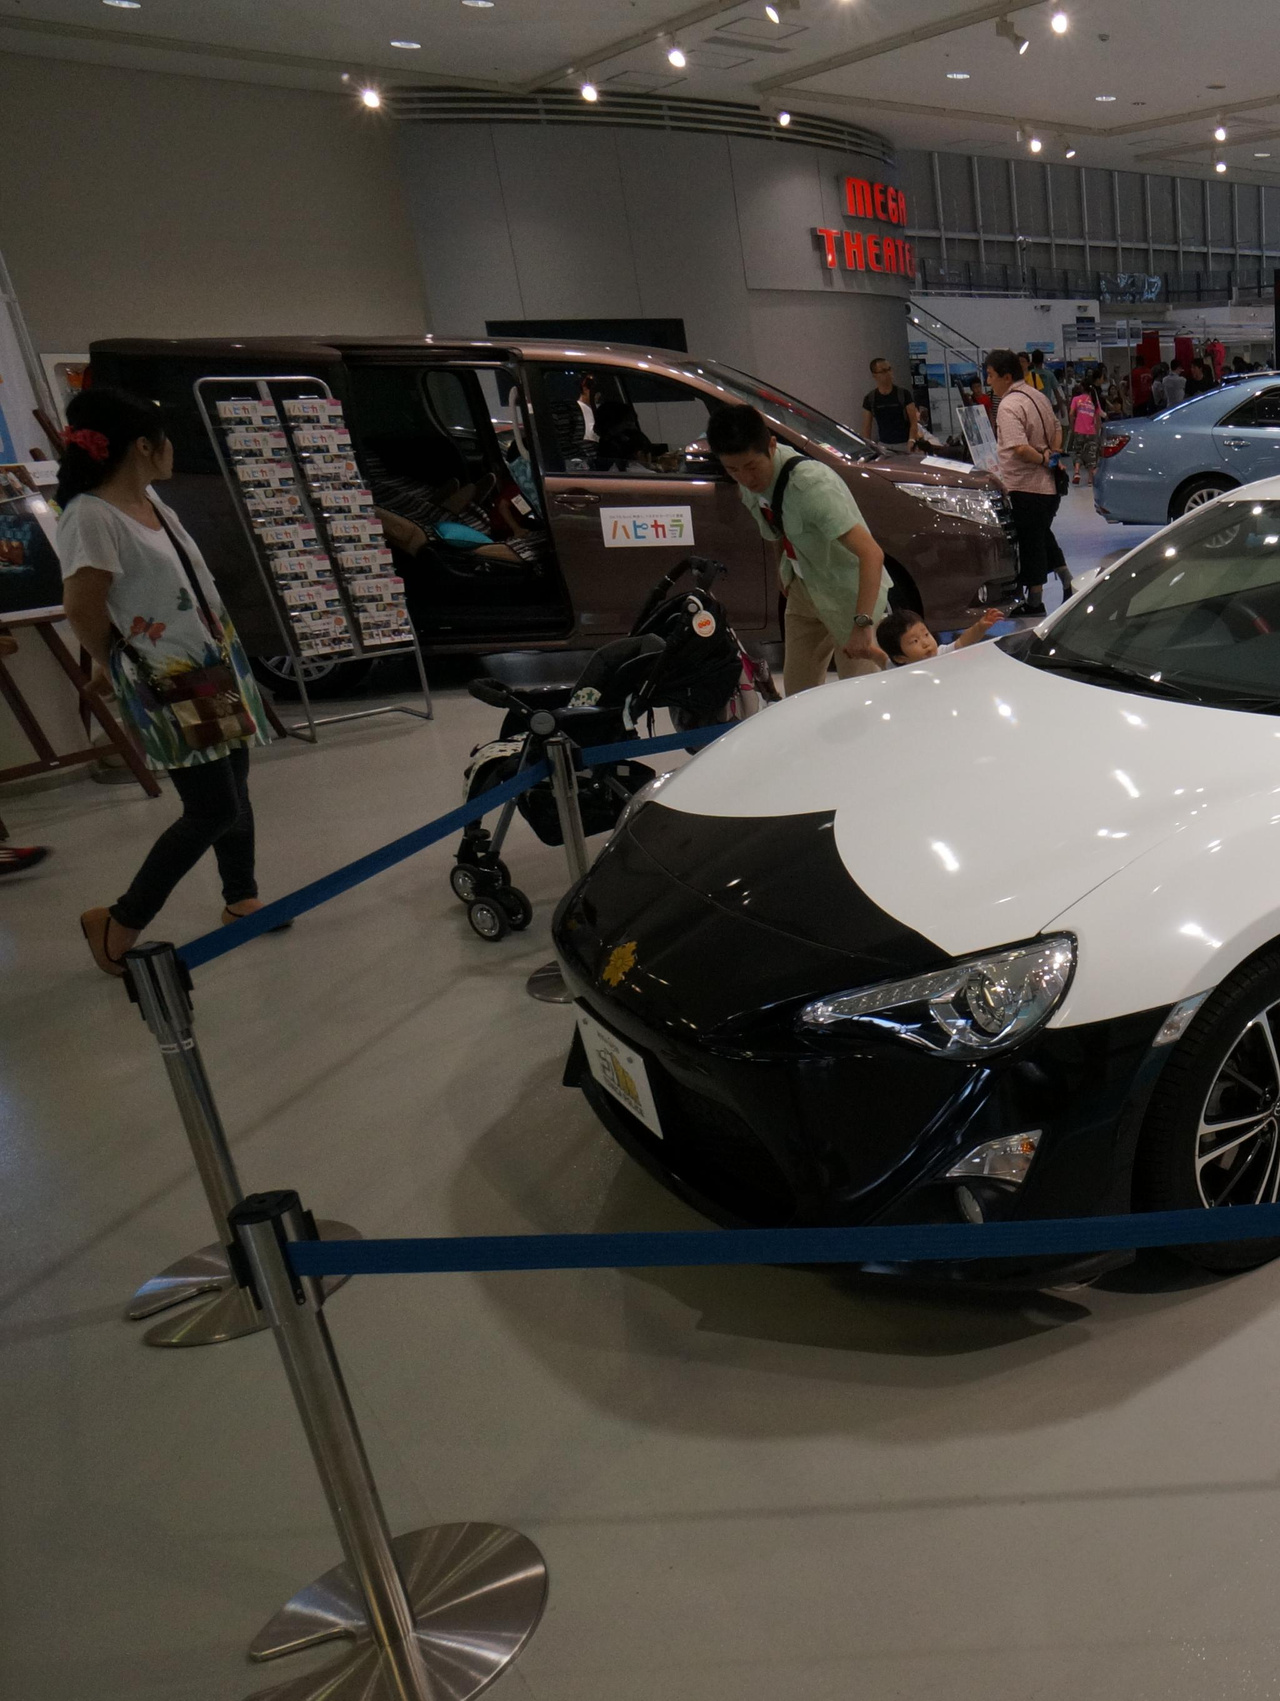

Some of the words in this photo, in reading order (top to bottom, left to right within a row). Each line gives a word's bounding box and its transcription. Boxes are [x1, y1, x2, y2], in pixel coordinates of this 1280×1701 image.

[845, 176, 908, 227] MEGA
[817, 227, 917, 279] THEATE
[611, 519, 684, 540] ハピカラ
